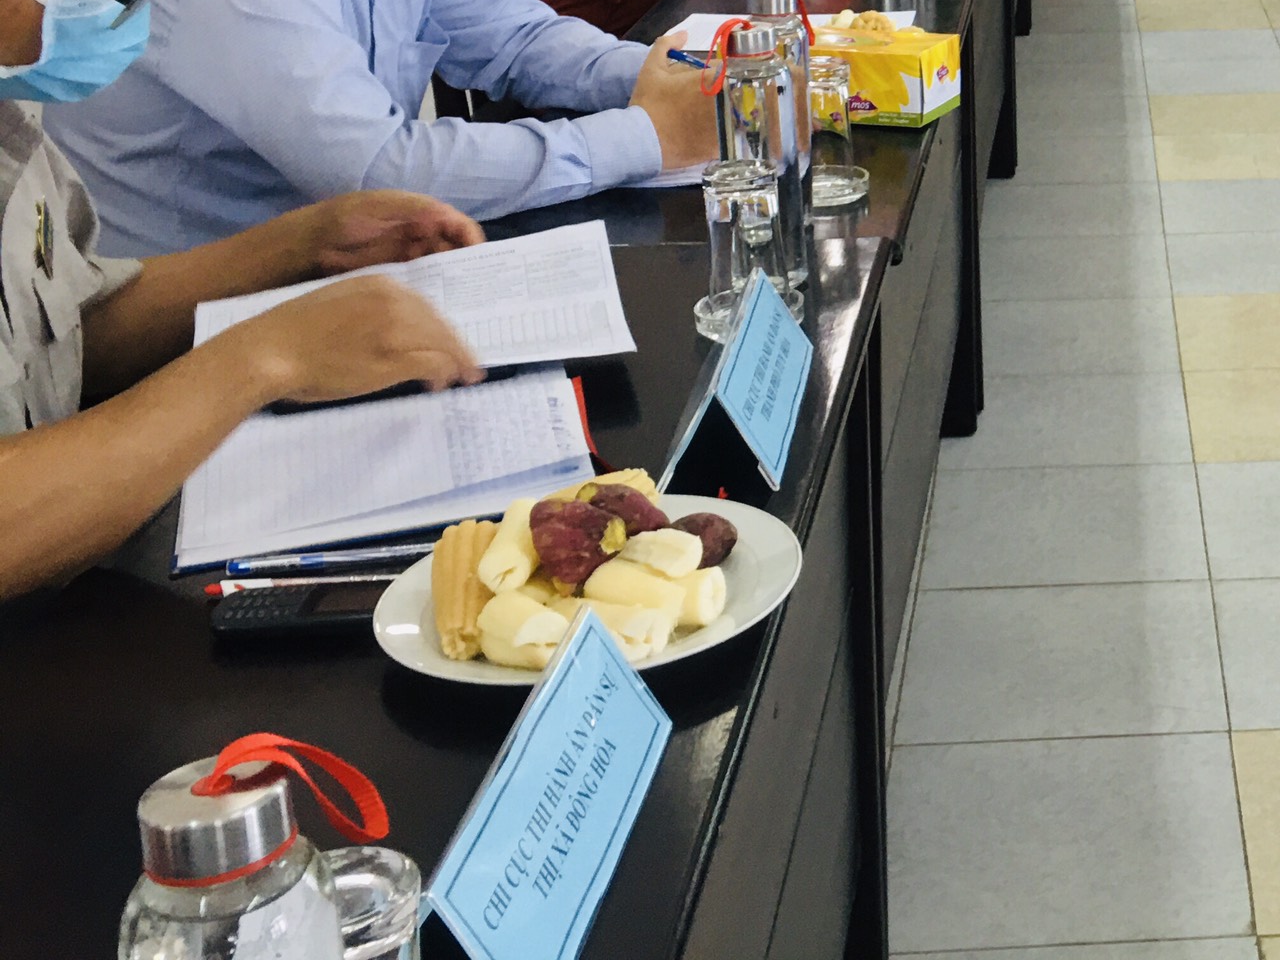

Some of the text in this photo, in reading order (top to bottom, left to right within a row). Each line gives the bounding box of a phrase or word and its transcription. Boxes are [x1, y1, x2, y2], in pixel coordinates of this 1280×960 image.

[482, 884, 510, 931] CHI
[504, 837, 534, 888] CỤC
[525, 797, 552, 844] THI
[548, 748, 577, 810] HÀNH
[566, 723, 592, 761] ÁN
[532, 856, 563, 900] THỊ
[553, 823, 574, 864] XÃ
[594, 737, 618, 788] HÒA
